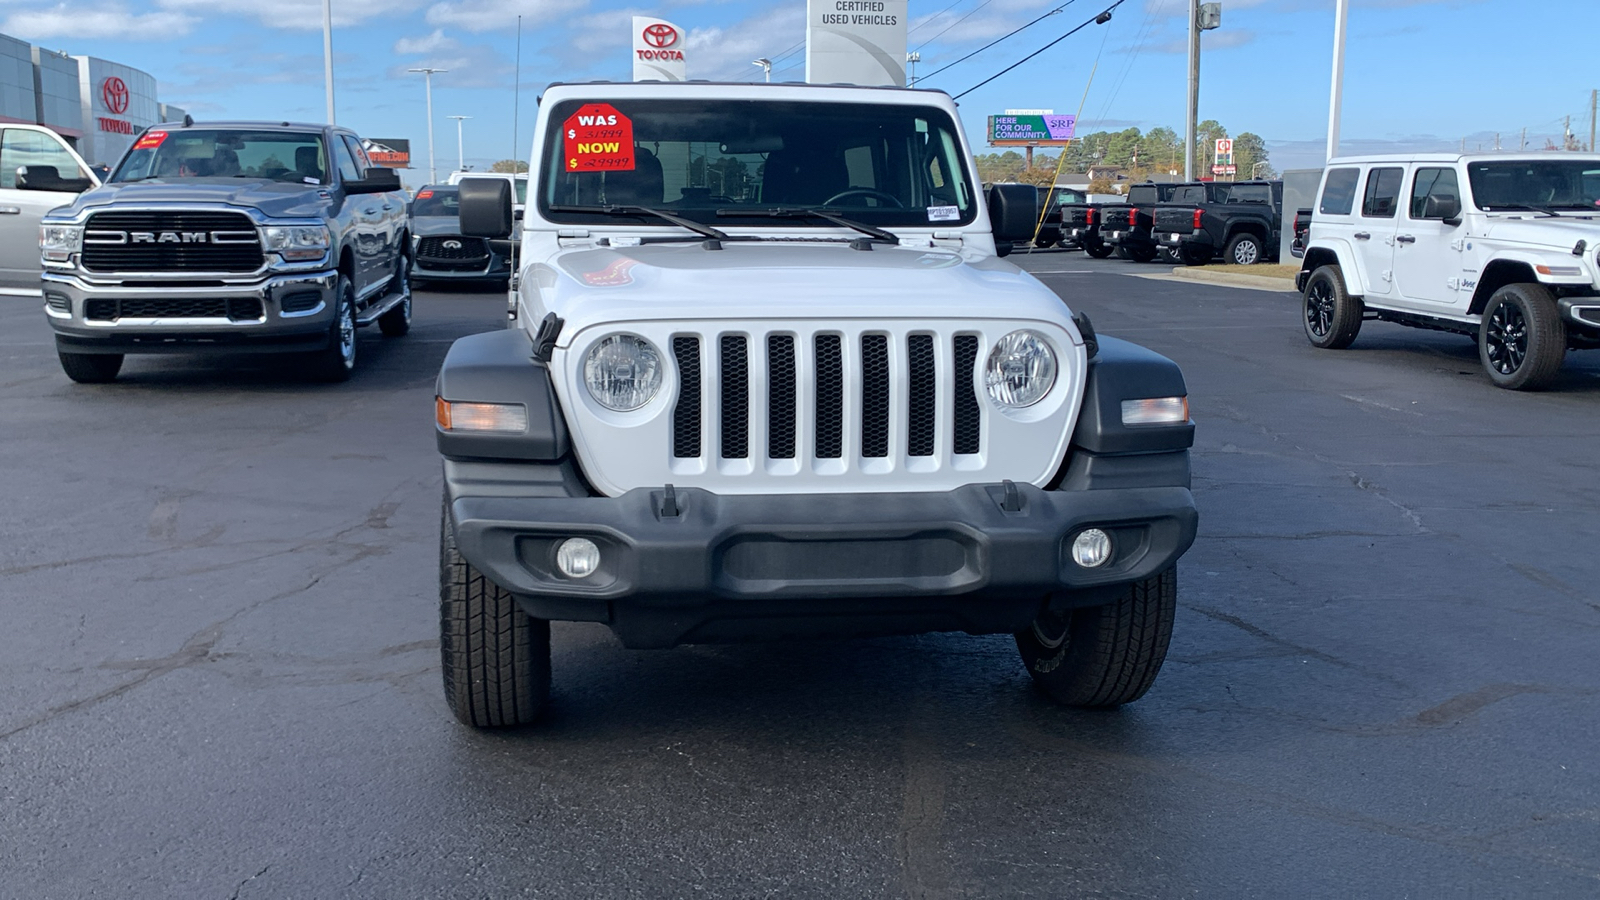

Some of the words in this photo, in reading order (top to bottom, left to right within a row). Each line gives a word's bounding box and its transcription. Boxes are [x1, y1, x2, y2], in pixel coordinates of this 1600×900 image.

[836, 1, 884, 12] CERTIFIED
[822, 14, 849, 24] USED
[852, 15, 897, 26] VEHICLES
[636, 50, 684, 60] TOYOTA
[98, 117, 133, 135] TOYOTA
[578, 115, 617, 126] WAS
[1050, 119, 1074, 128] SRP
[995, 131, 1047, 139] COMMUNITY
[577, 142, 619, 154] NOW
[130, 232, 207, 243] RAM
